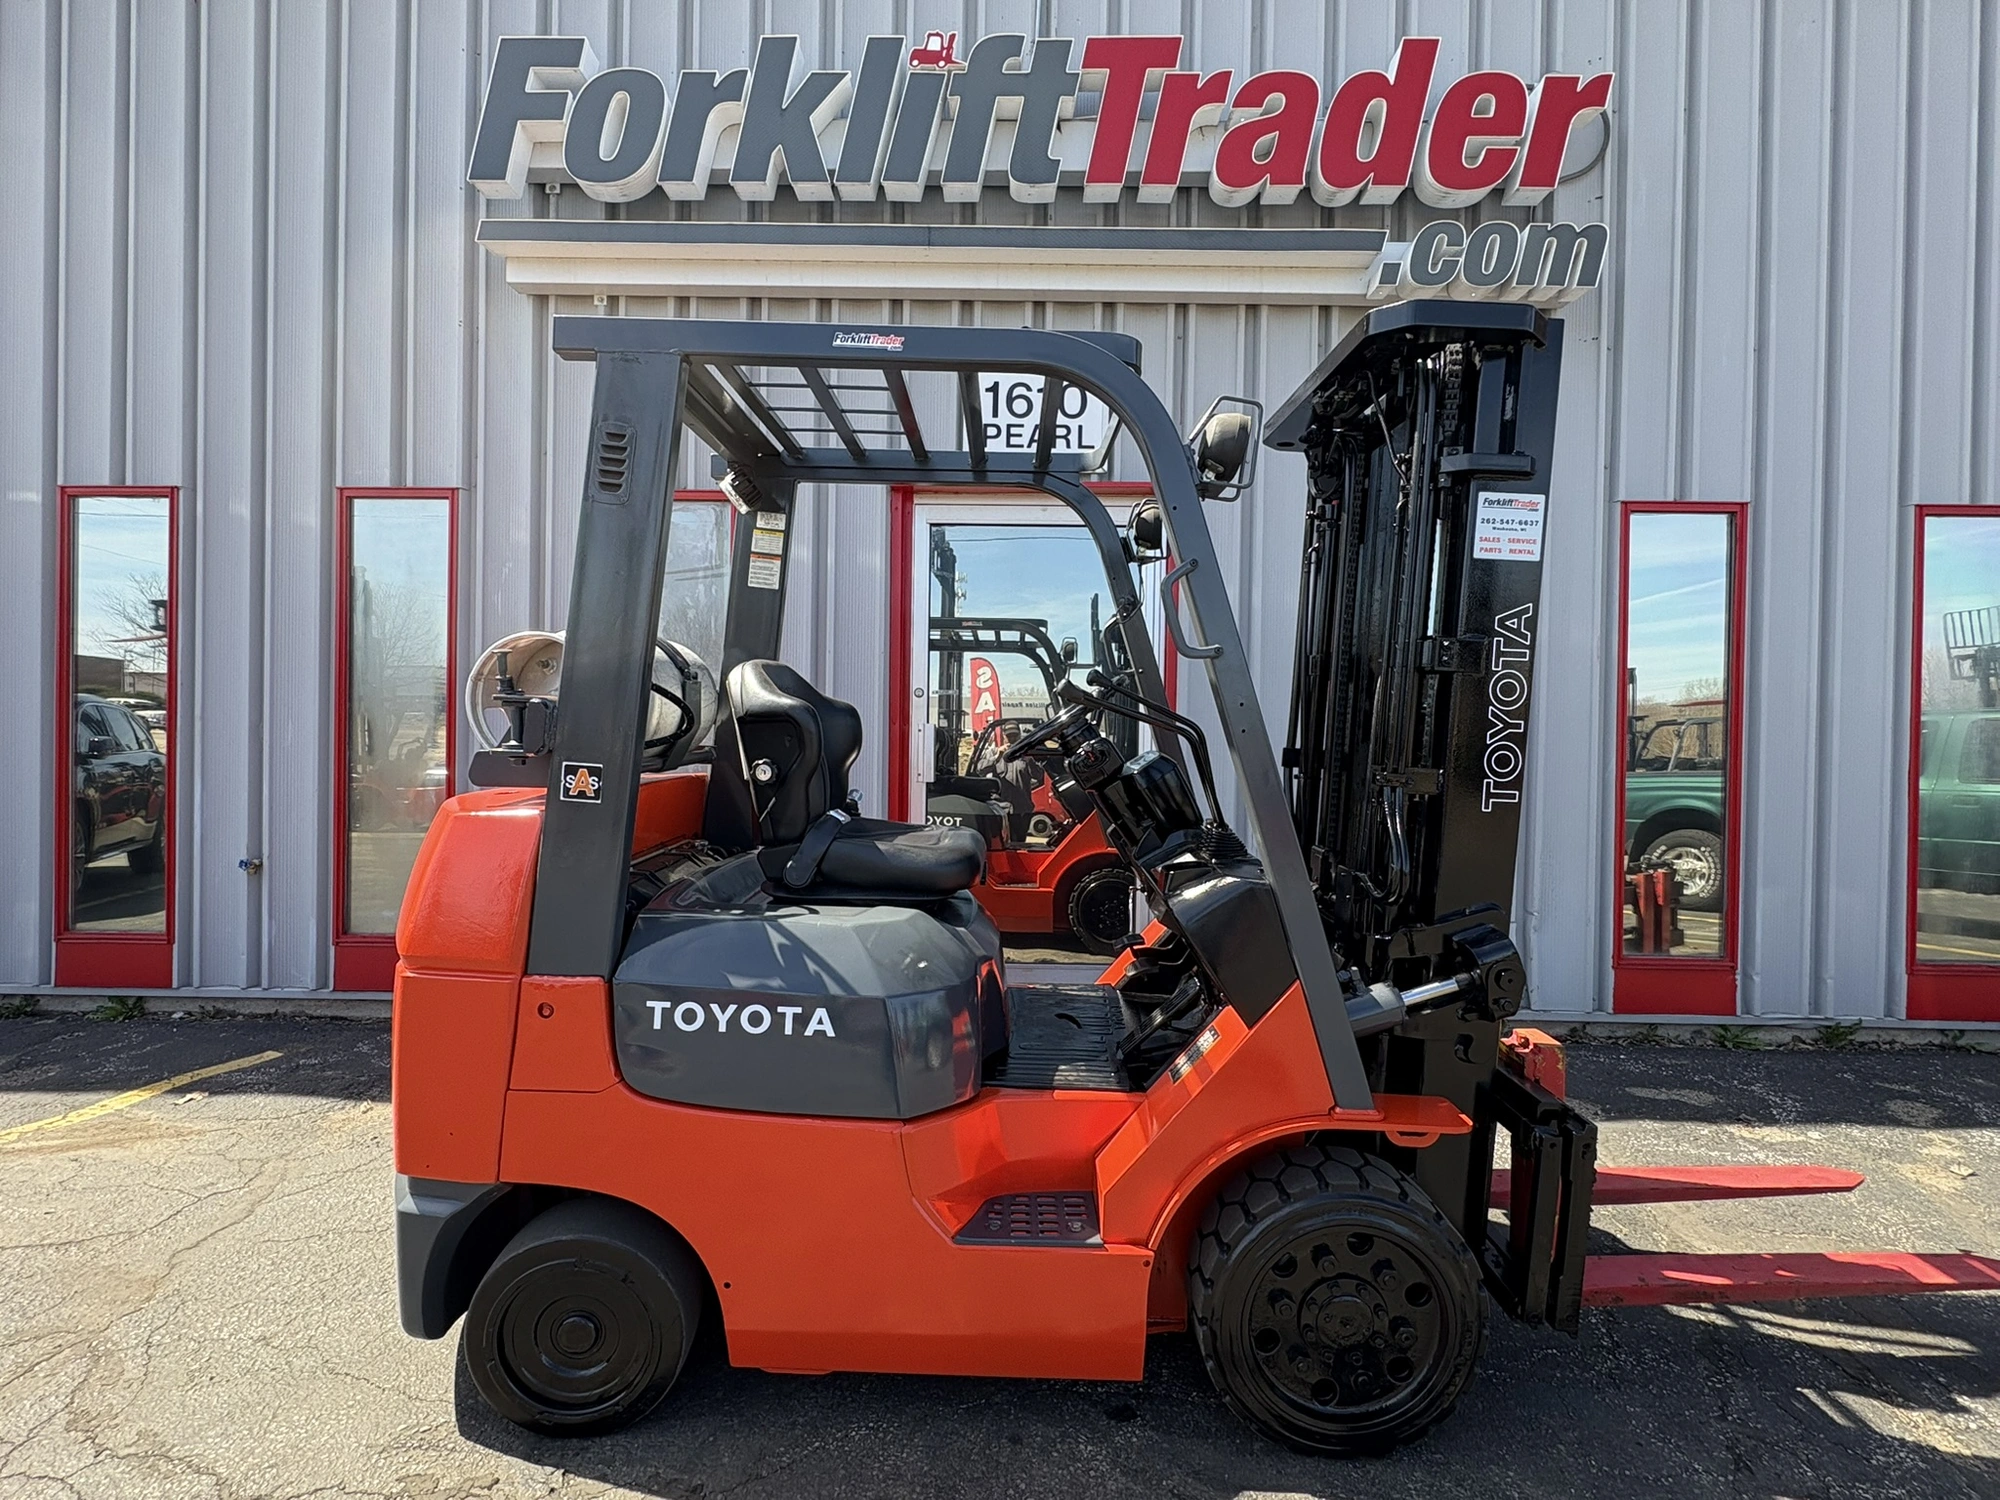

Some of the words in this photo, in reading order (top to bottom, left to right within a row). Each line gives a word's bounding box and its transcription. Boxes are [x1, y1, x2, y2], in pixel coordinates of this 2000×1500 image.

[466, 33, 1616, 200] ForkliftTrader
[1376, 219, 1610, 292] .com
[833, 332, 904, 346] ForkliftTrader
[985, 381, 1088, 419] 160
[1482, 497, 1541, 508] ForkliftTrader
[1479, 536, 1501, 544] SALES
[1507, 537, 1538, 545] SERVICE
[1479, 546, 1502, 554] PARTS
[1508, 548, 1536, 556] RENTAL
[1481, 602, 1533, 813] TOYOTA
[645, 1000, 836, 1038] TOYOTA
